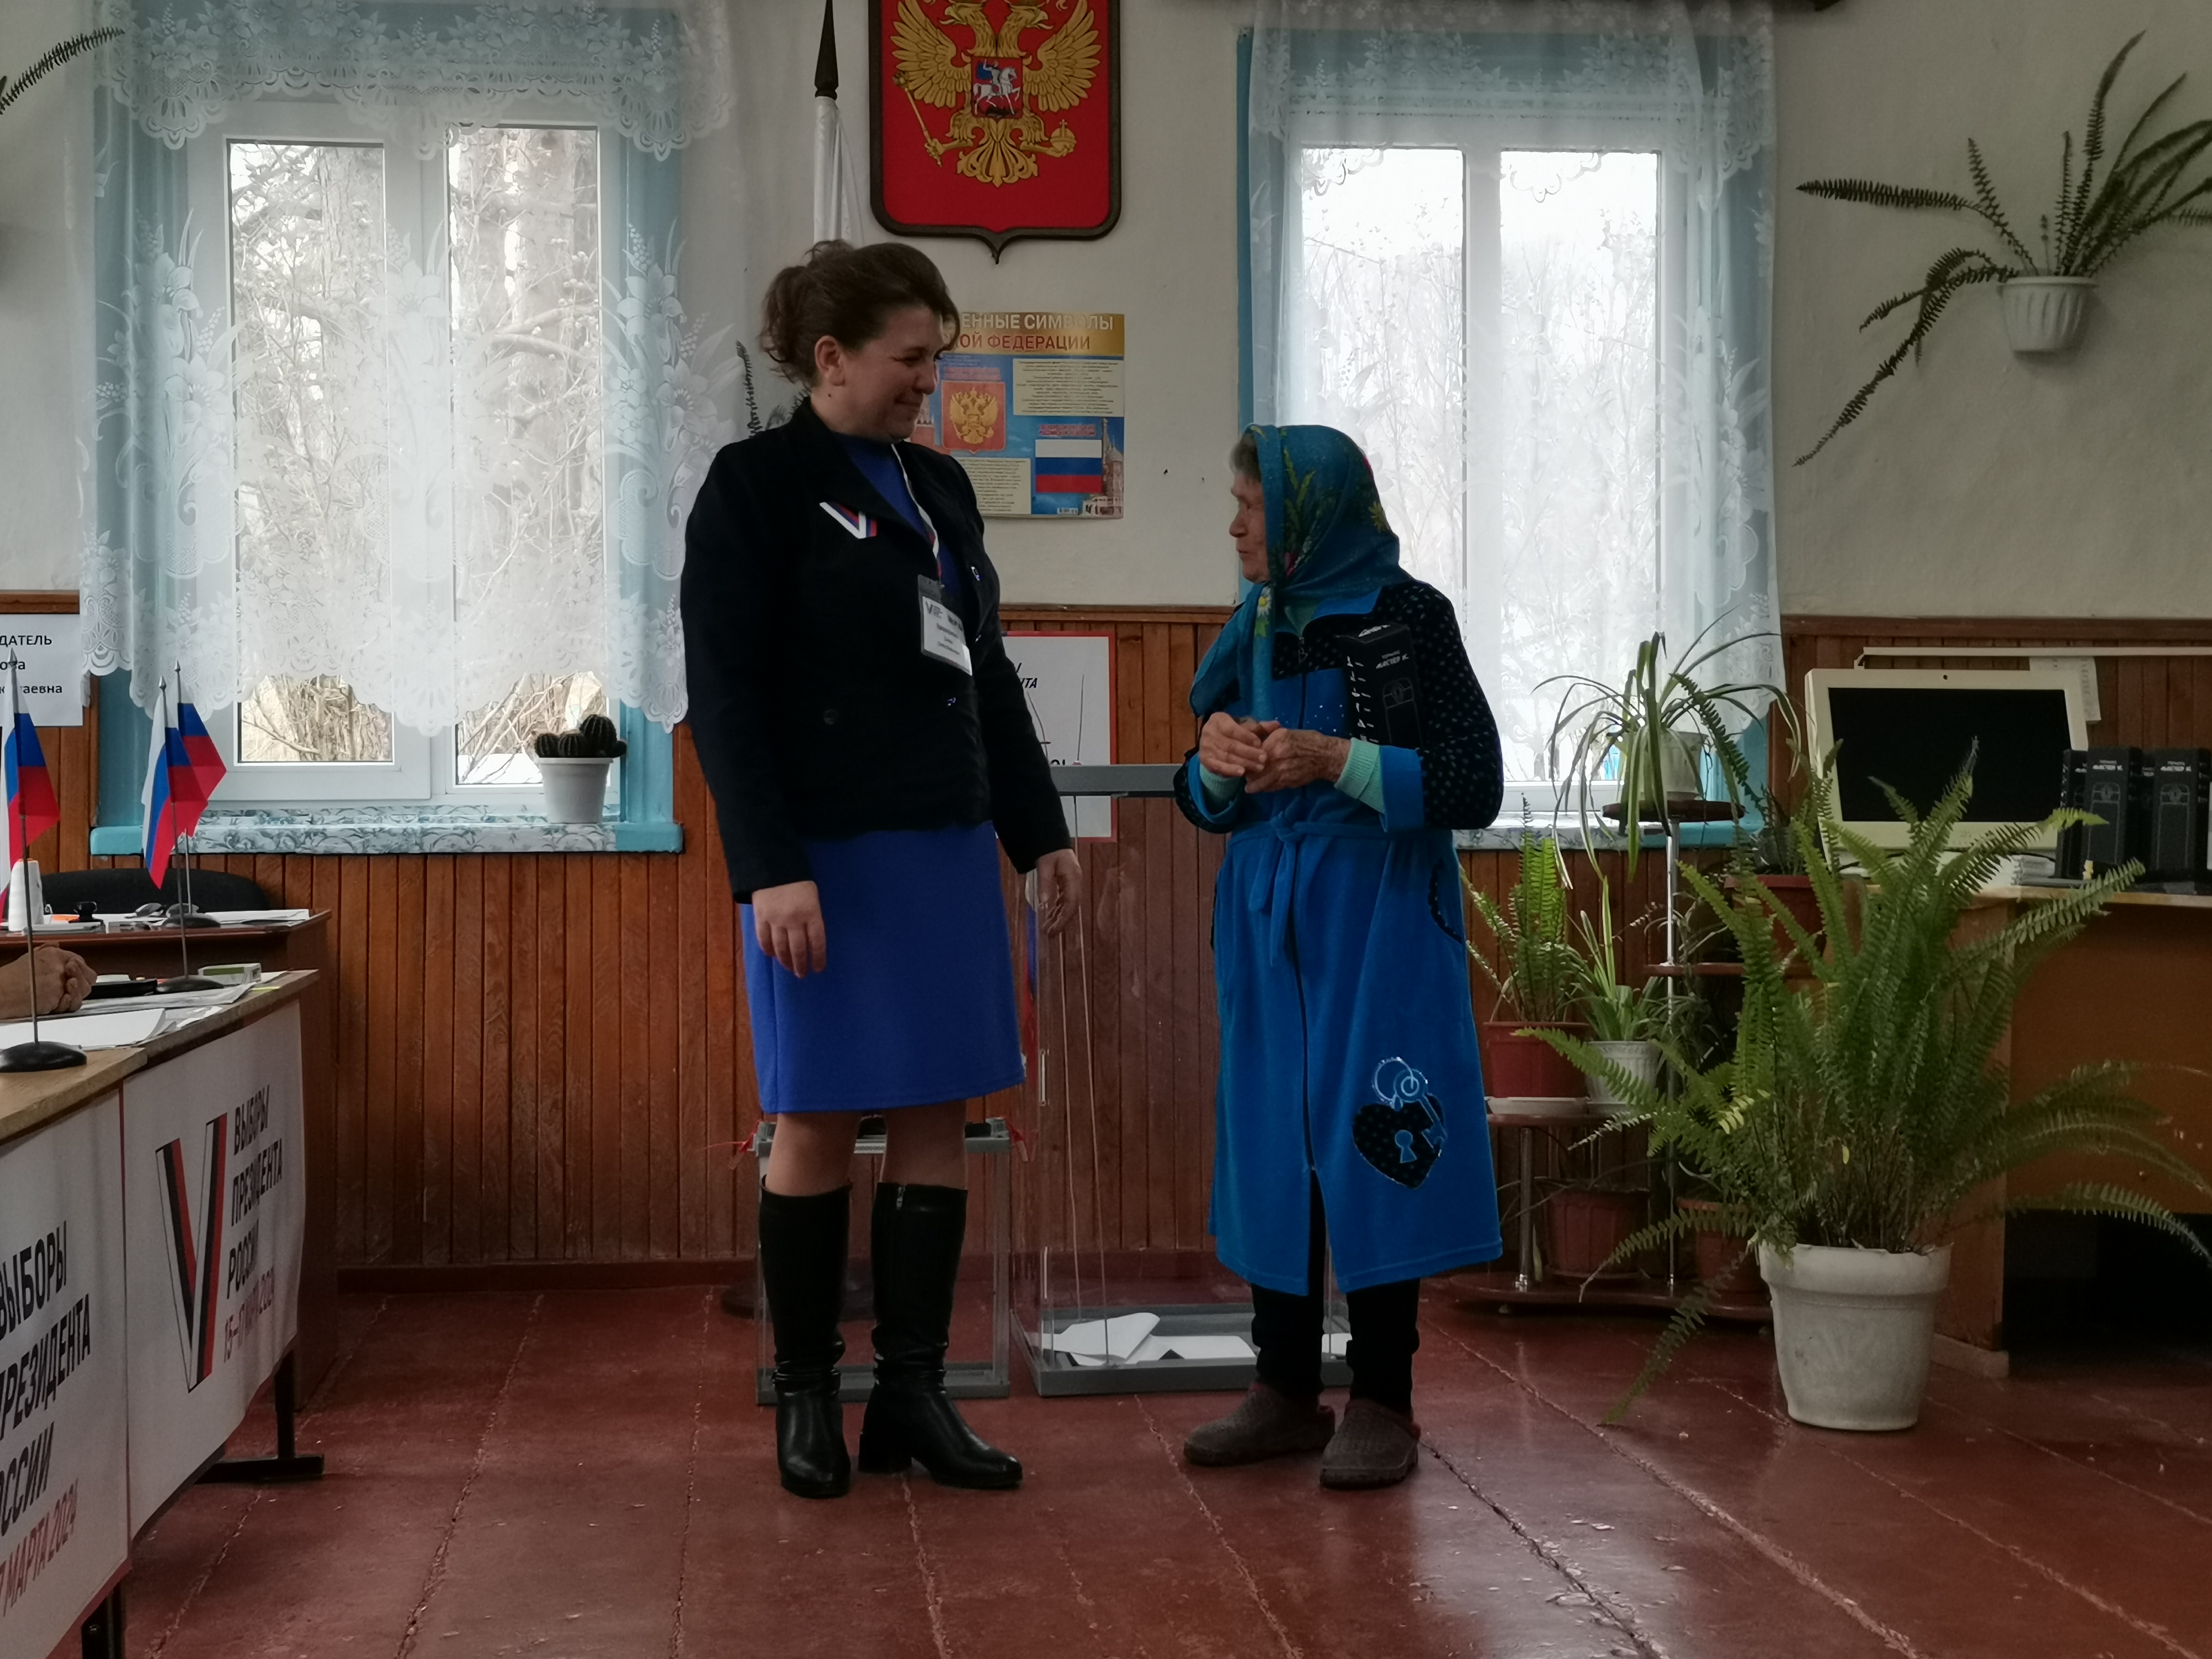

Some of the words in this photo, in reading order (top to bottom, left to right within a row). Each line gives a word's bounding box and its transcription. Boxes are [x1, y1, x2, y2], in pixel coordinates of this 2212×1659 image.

[1024, 314, 1113, 330] СИМВОЛЫ
[956, 331, 982, 348] ОЙ
[987, 335, 1090, 351] ФЕДЕРАЦИИ
[0, 635, 52, 648] ДАТЕЛЬ
[231, 1138, 283, 1227] ПРЕЗДЕНТА
